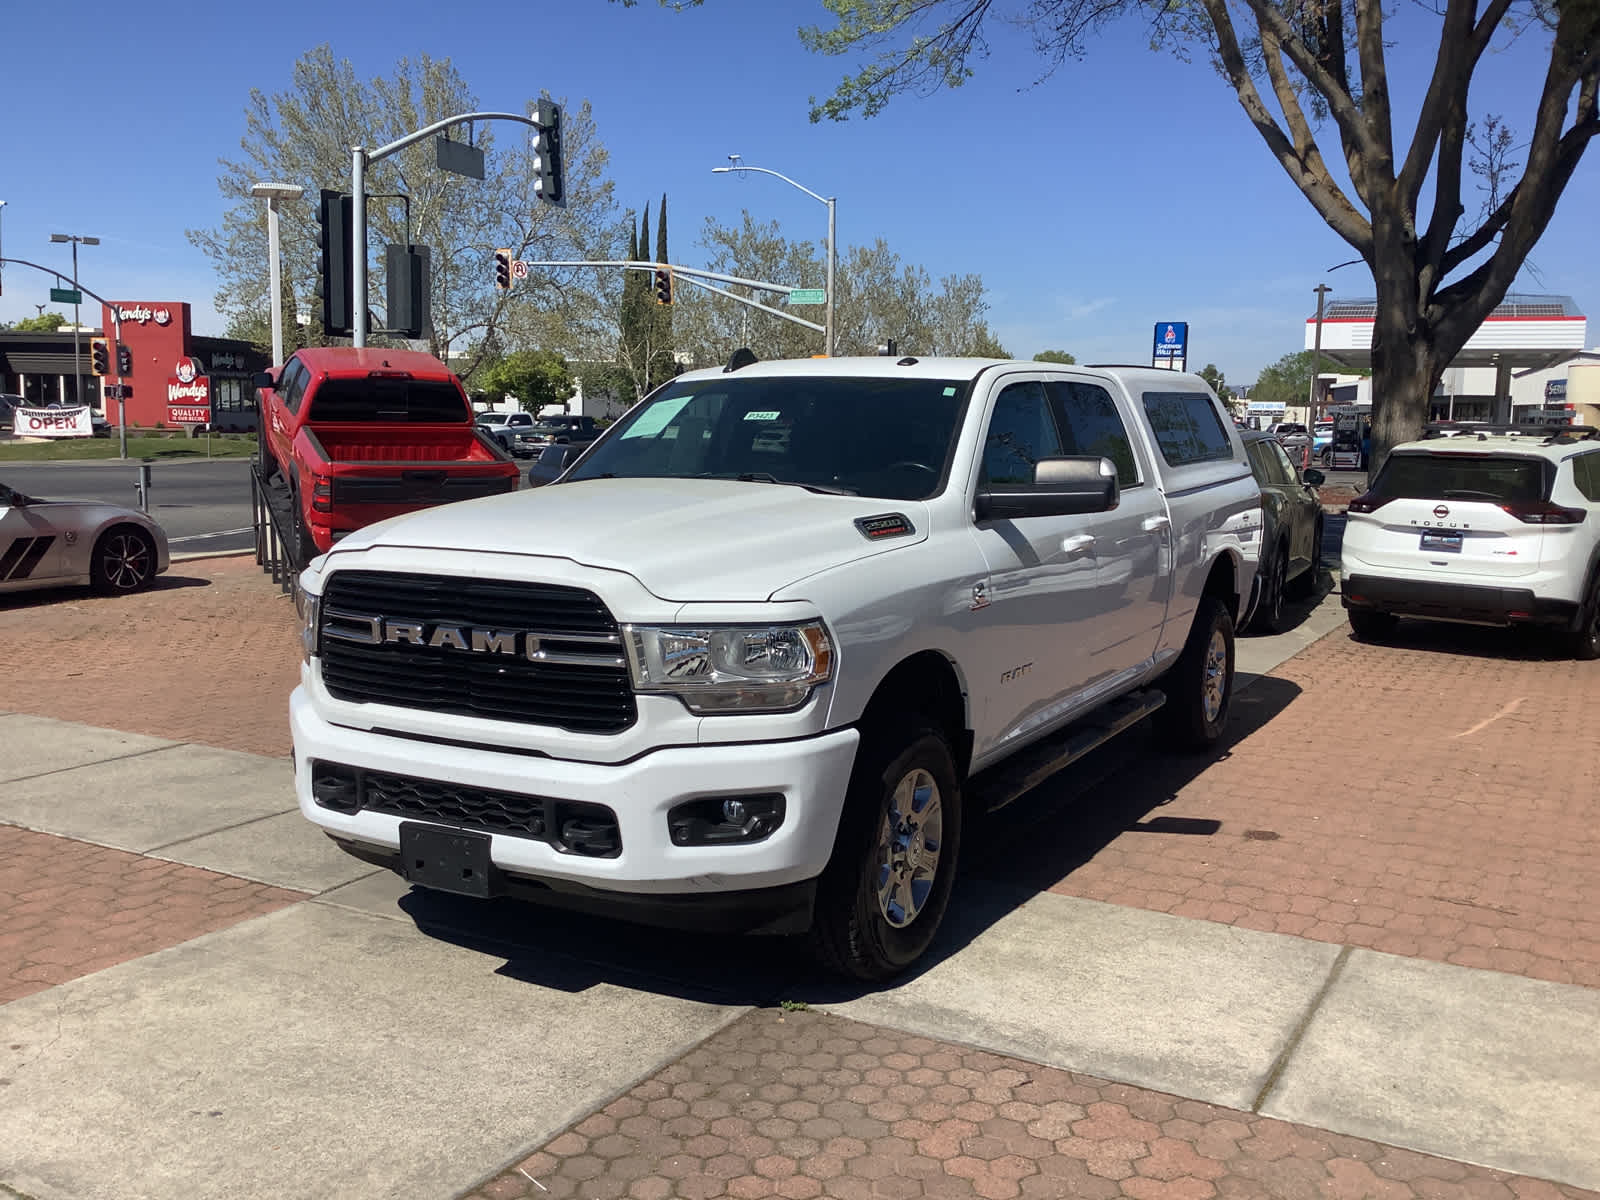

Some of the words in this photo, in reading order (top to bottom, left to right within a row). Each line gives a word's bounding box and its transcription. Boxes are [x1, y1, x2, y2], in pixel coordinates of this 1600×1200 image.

[111, 304, 151, 323] Wendy's
[168, 380, 207, 402] Wendy's
[171, 408, 205, 417] QUALITY
[29, 416, 78, 430] OPEN
[1410, 519, 1471, 529] ROGUE
[384, 621, 517, 655] RAM
